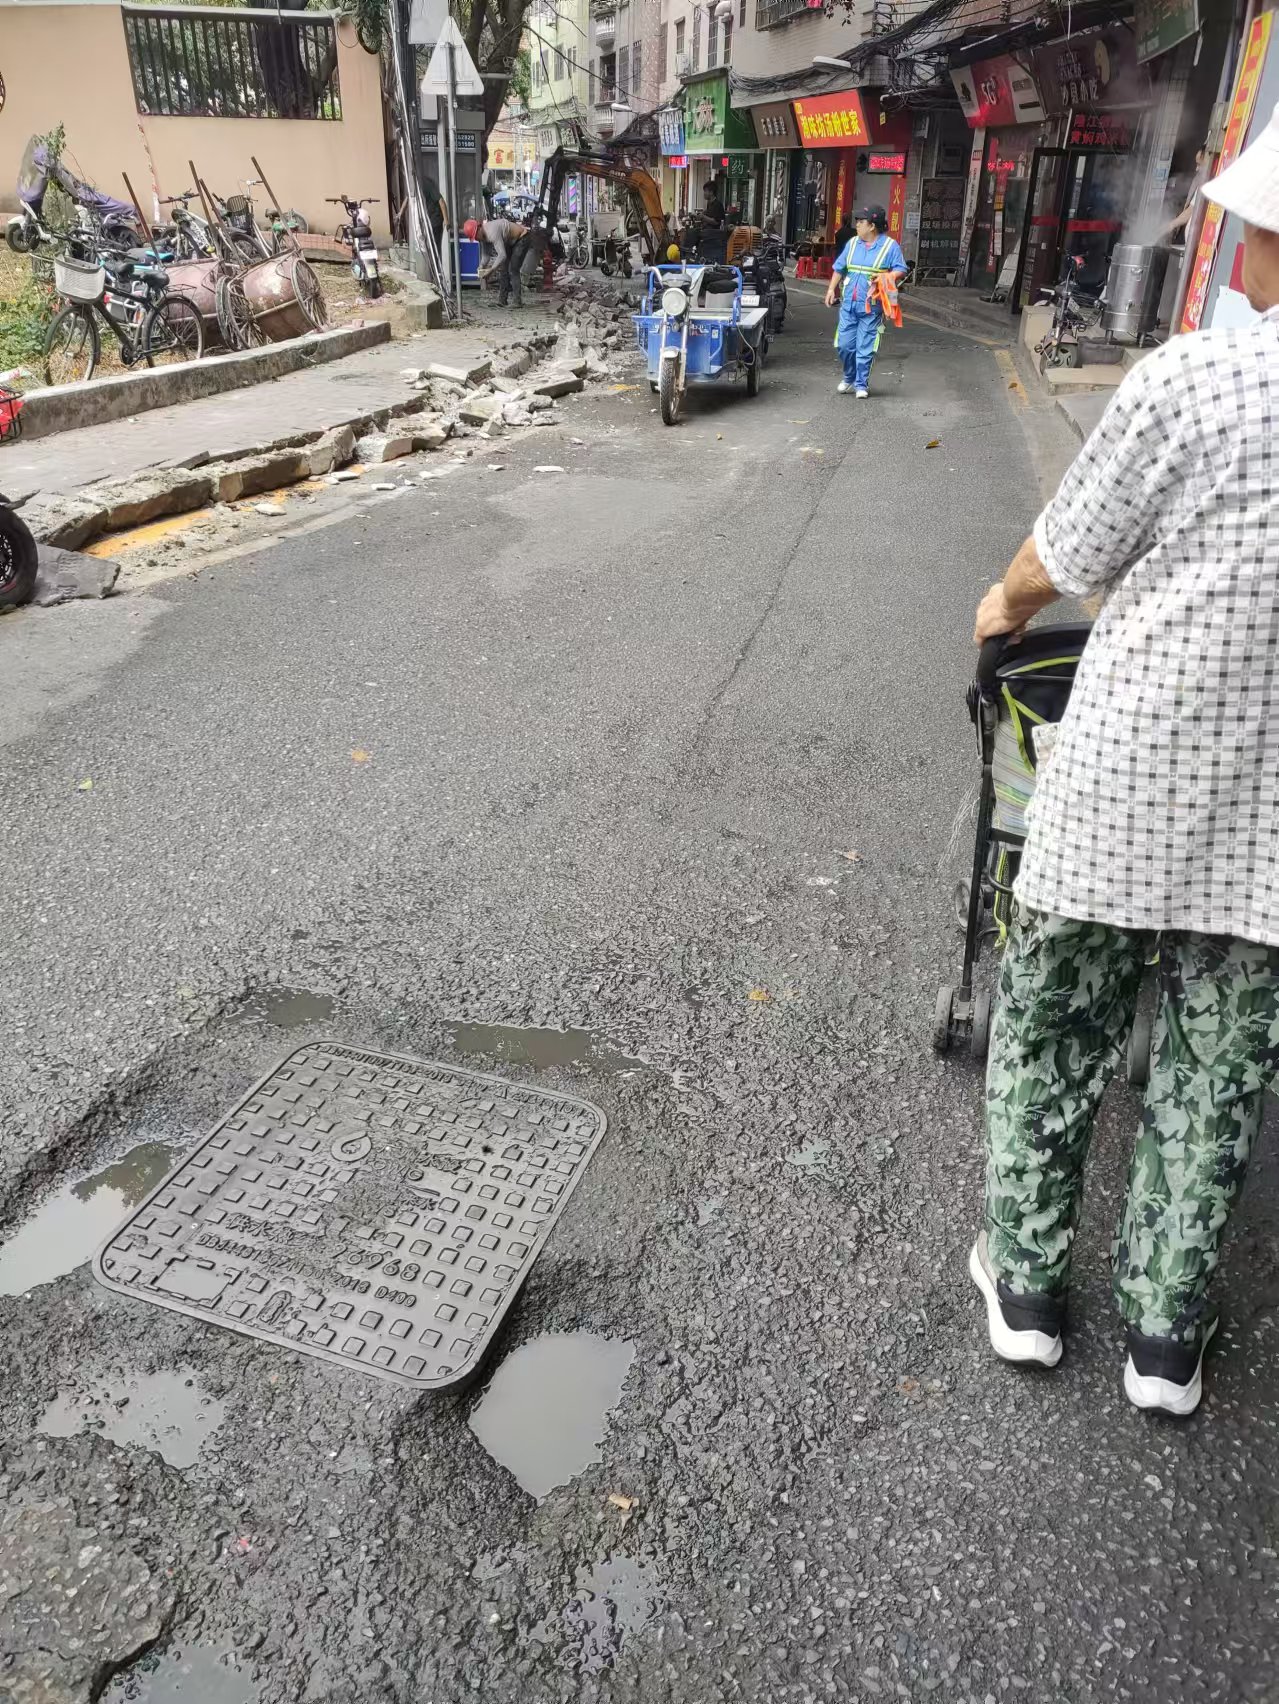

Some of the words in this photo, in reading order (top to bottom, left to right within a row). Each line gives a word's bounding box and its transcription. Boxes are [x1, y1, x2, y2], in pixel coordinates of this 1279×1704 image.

[1061, 77, 1099, 106] 沙县小吃
[731, 159, 744, 175] 药
[372, 1284, 419, 1308] D400
